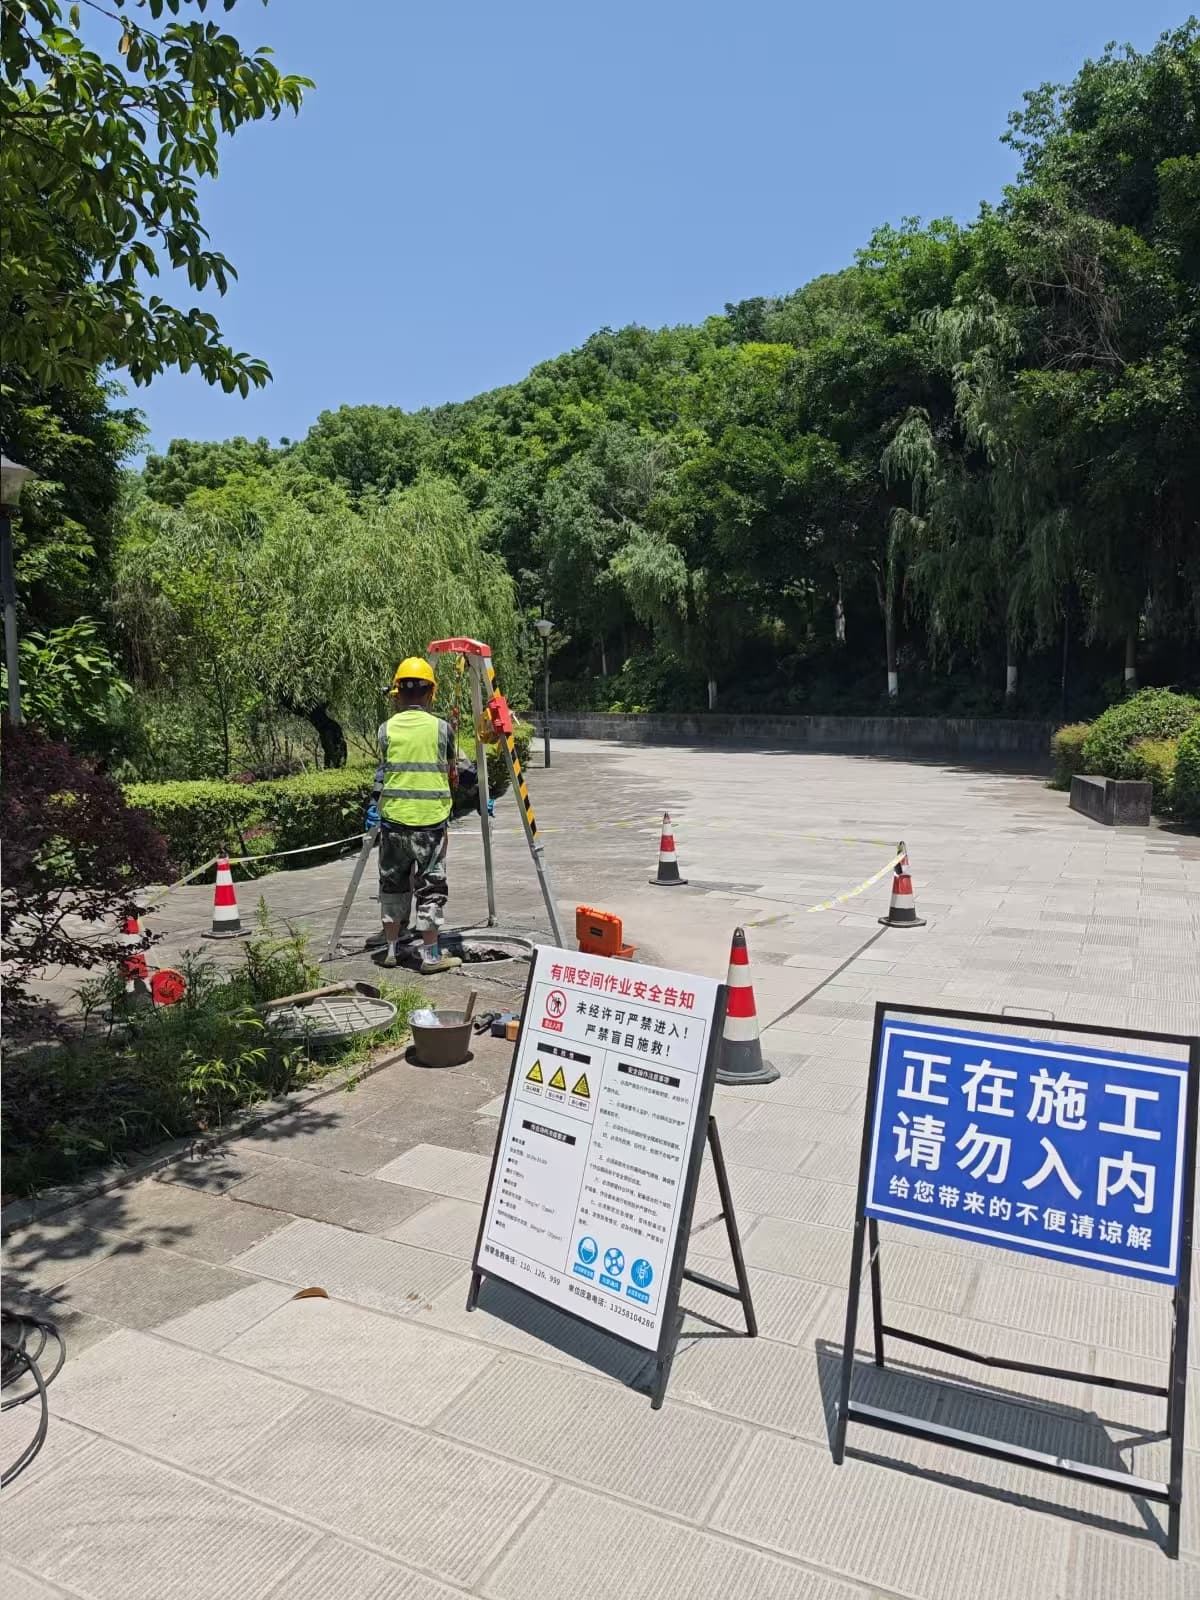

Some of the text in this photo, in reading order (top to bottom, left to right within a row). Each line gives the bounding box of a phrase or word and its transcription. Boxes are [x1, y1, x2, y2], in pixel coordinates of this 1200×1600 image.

[551, 963, 695, 1010] 有限空间作业安全告知
[576, 1000, 688, 1040] 未经许可严禁进入！
[585, 1023, 670, 1057] 严禁盲目施救！
[897, 1050, 1161, 1141] 正在施工
[892, 1111, 1156, 1214] 请勿入内
[889, 1174, 1152, 1251] 给您带来的不便请谅解
